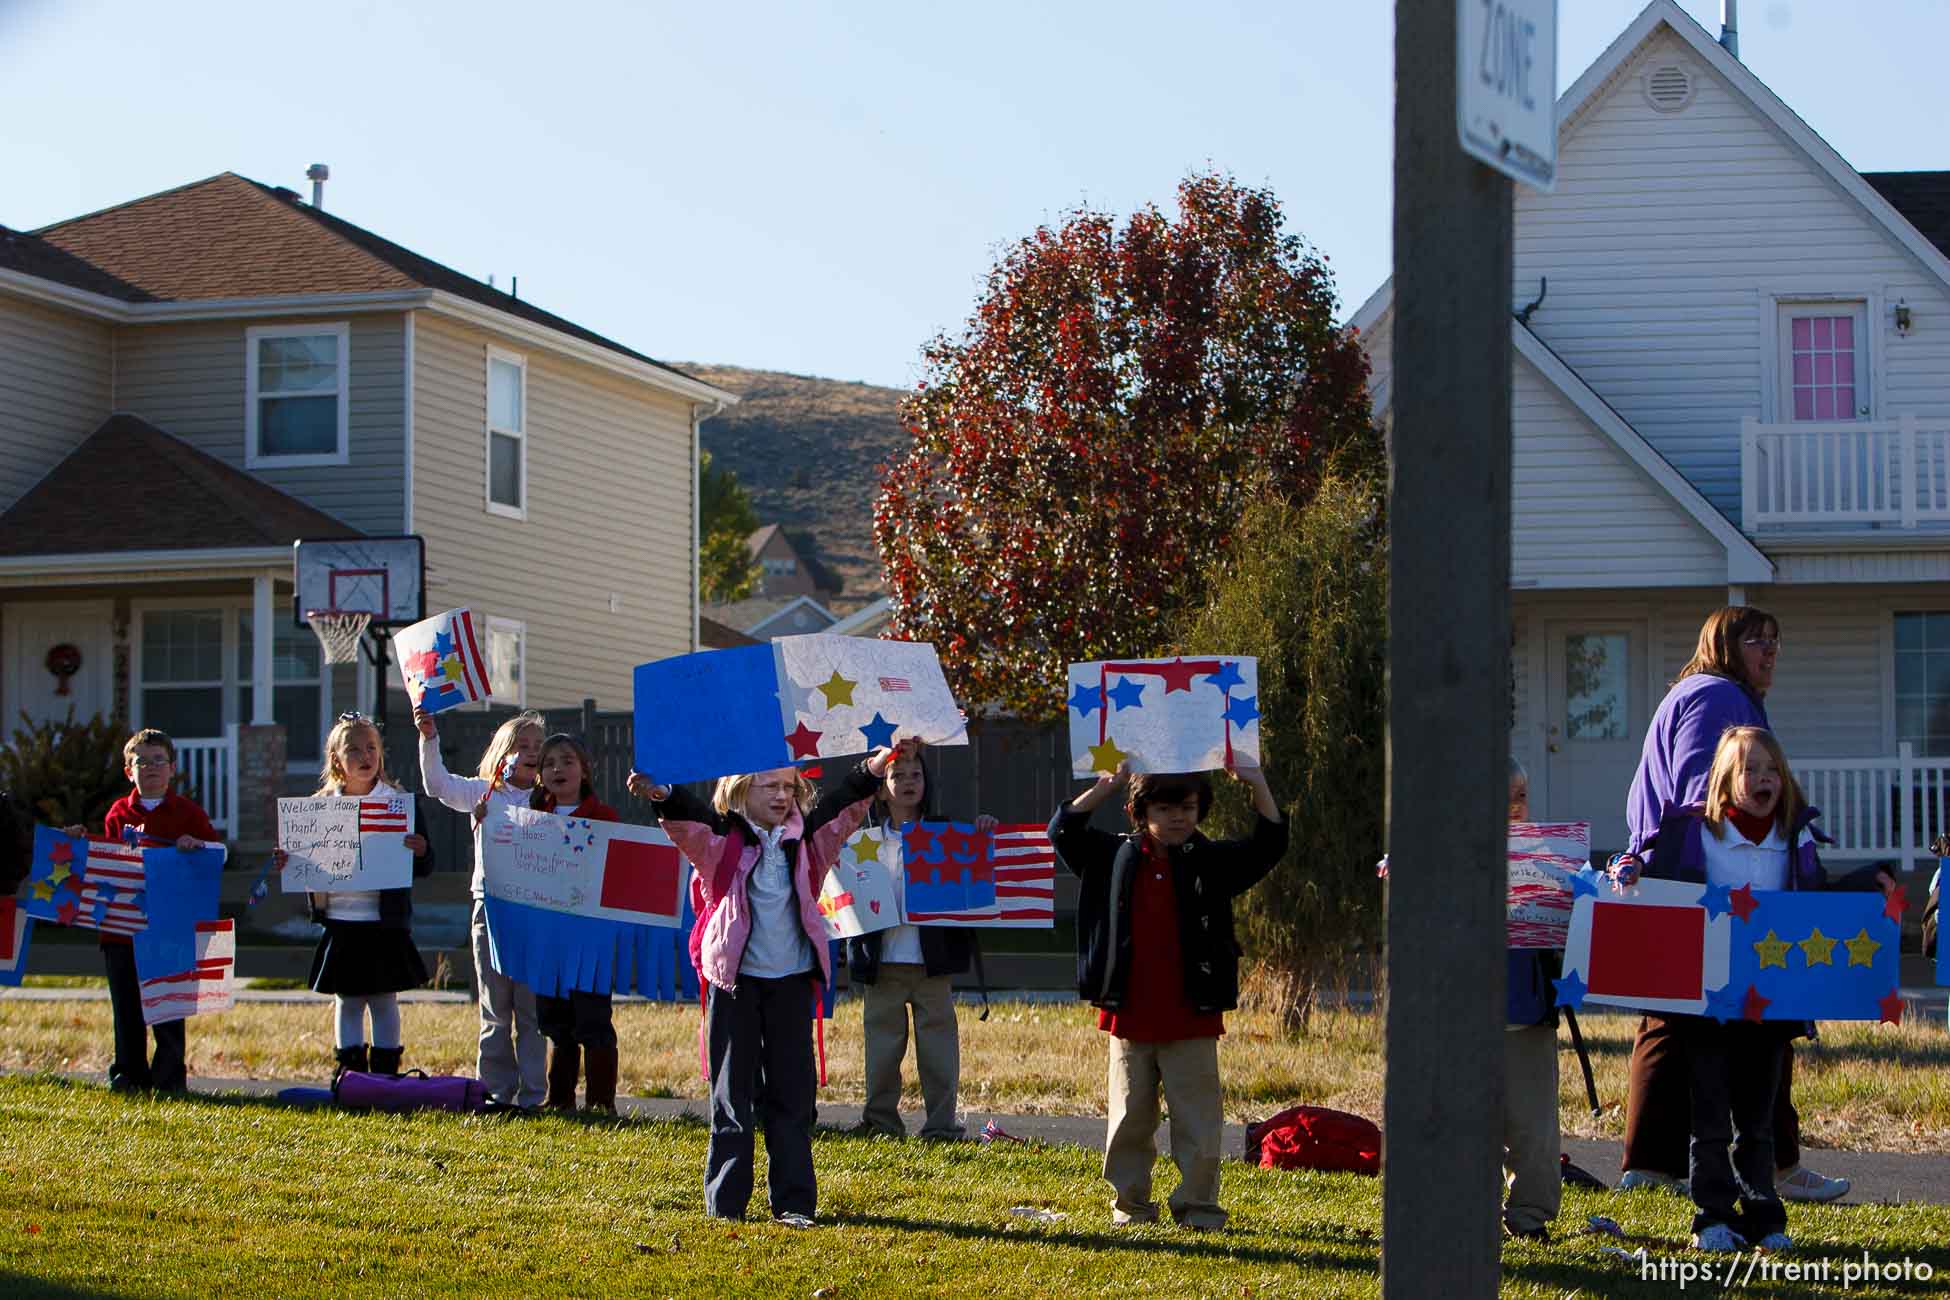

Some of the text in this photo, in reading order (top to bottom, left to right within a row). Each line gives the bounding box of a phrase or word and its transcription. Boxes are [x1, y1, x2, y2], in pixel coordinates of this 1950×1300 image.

[279, 800, 359, 814] Welcome Home
[283, 819, 344, 841] Thank you
[282, 837, 303, 850] for
[308, 840, 331, 858] your
